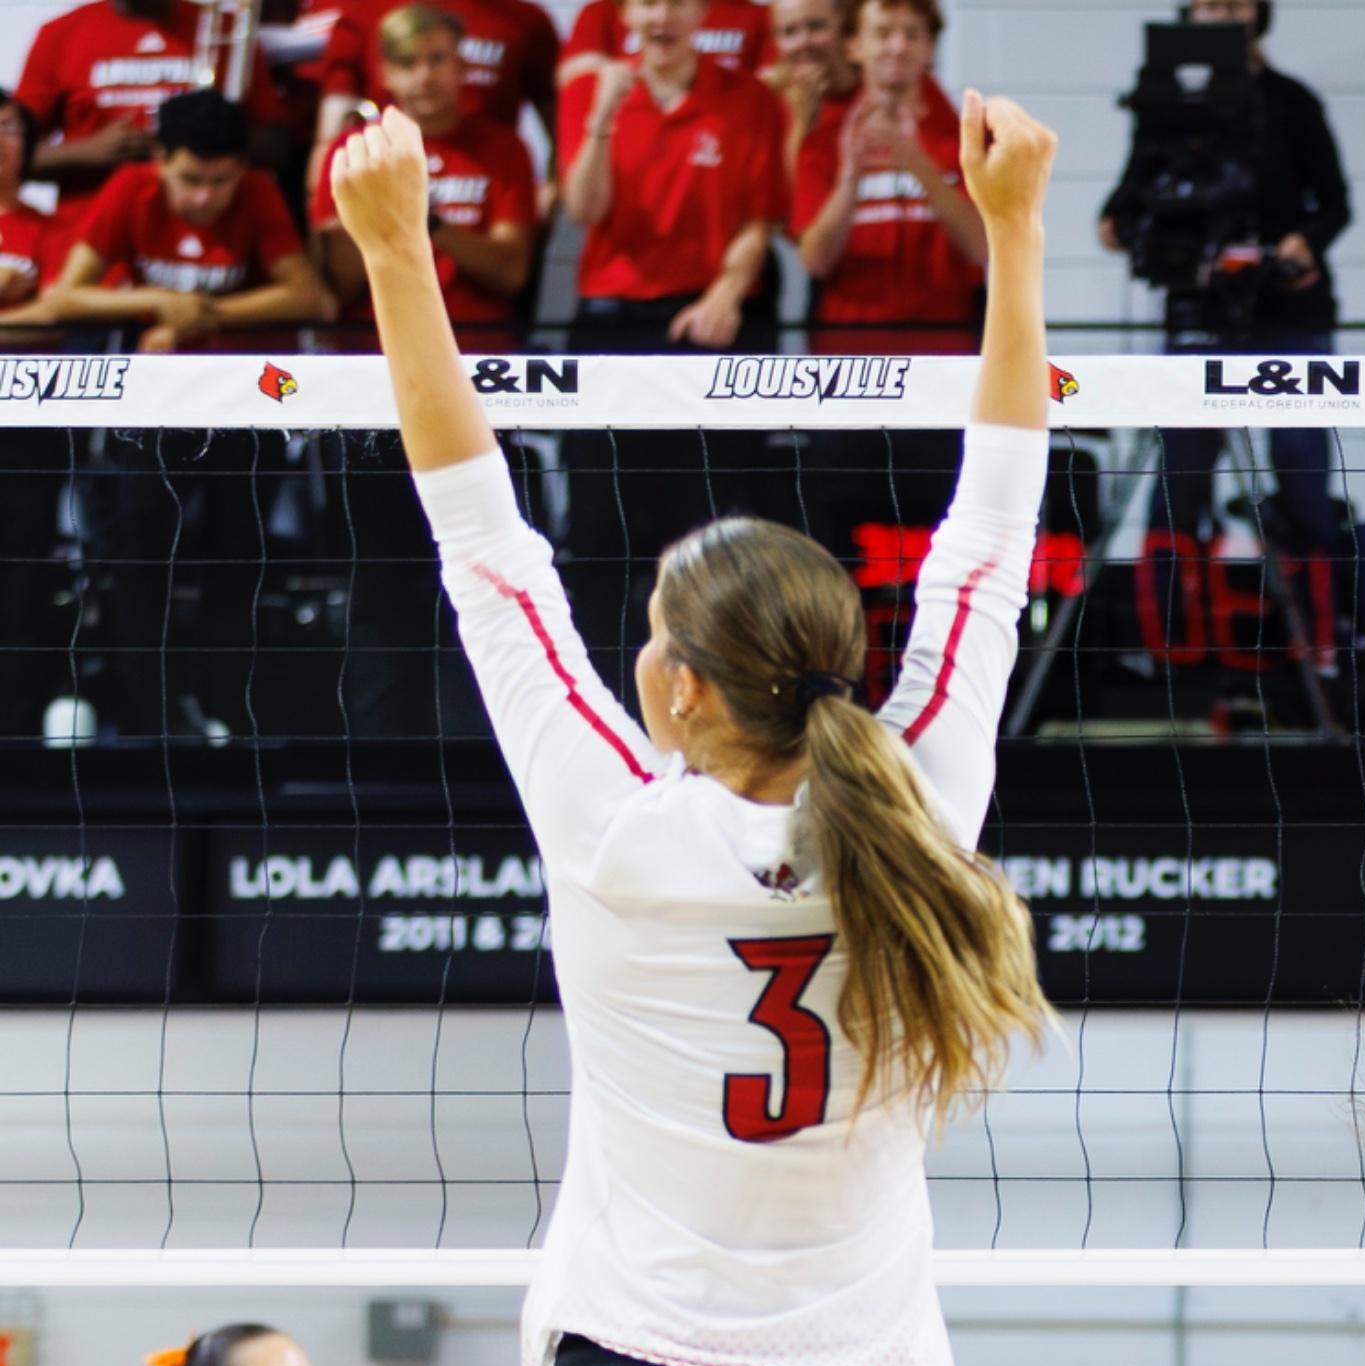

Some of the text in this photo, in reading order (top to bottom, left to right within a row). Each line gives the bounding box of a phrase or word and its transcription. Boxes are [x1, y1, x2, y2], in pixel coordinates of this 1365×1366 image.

[0, 358, 130, 405] ISVILLE
[470, 358, 578, 394] &N
[705, 357, 911, 404] LOUISVILLE
[1204, 359, 1360, 396] L&N
[485, 397, 579, 408] CREDIT UNION
[1203, 399, 1361, 409] FEDERAL CREDIT UNION
[230, 855, 361, 899] LOLA
[1079, 857, 1279, 899] RUCKER
[378, 914, 469, 951] 2011
[472, 914, 505, 951] &
[1048, 914, 1147, 951] 2012
[722, 933, 837, 1144] 3
